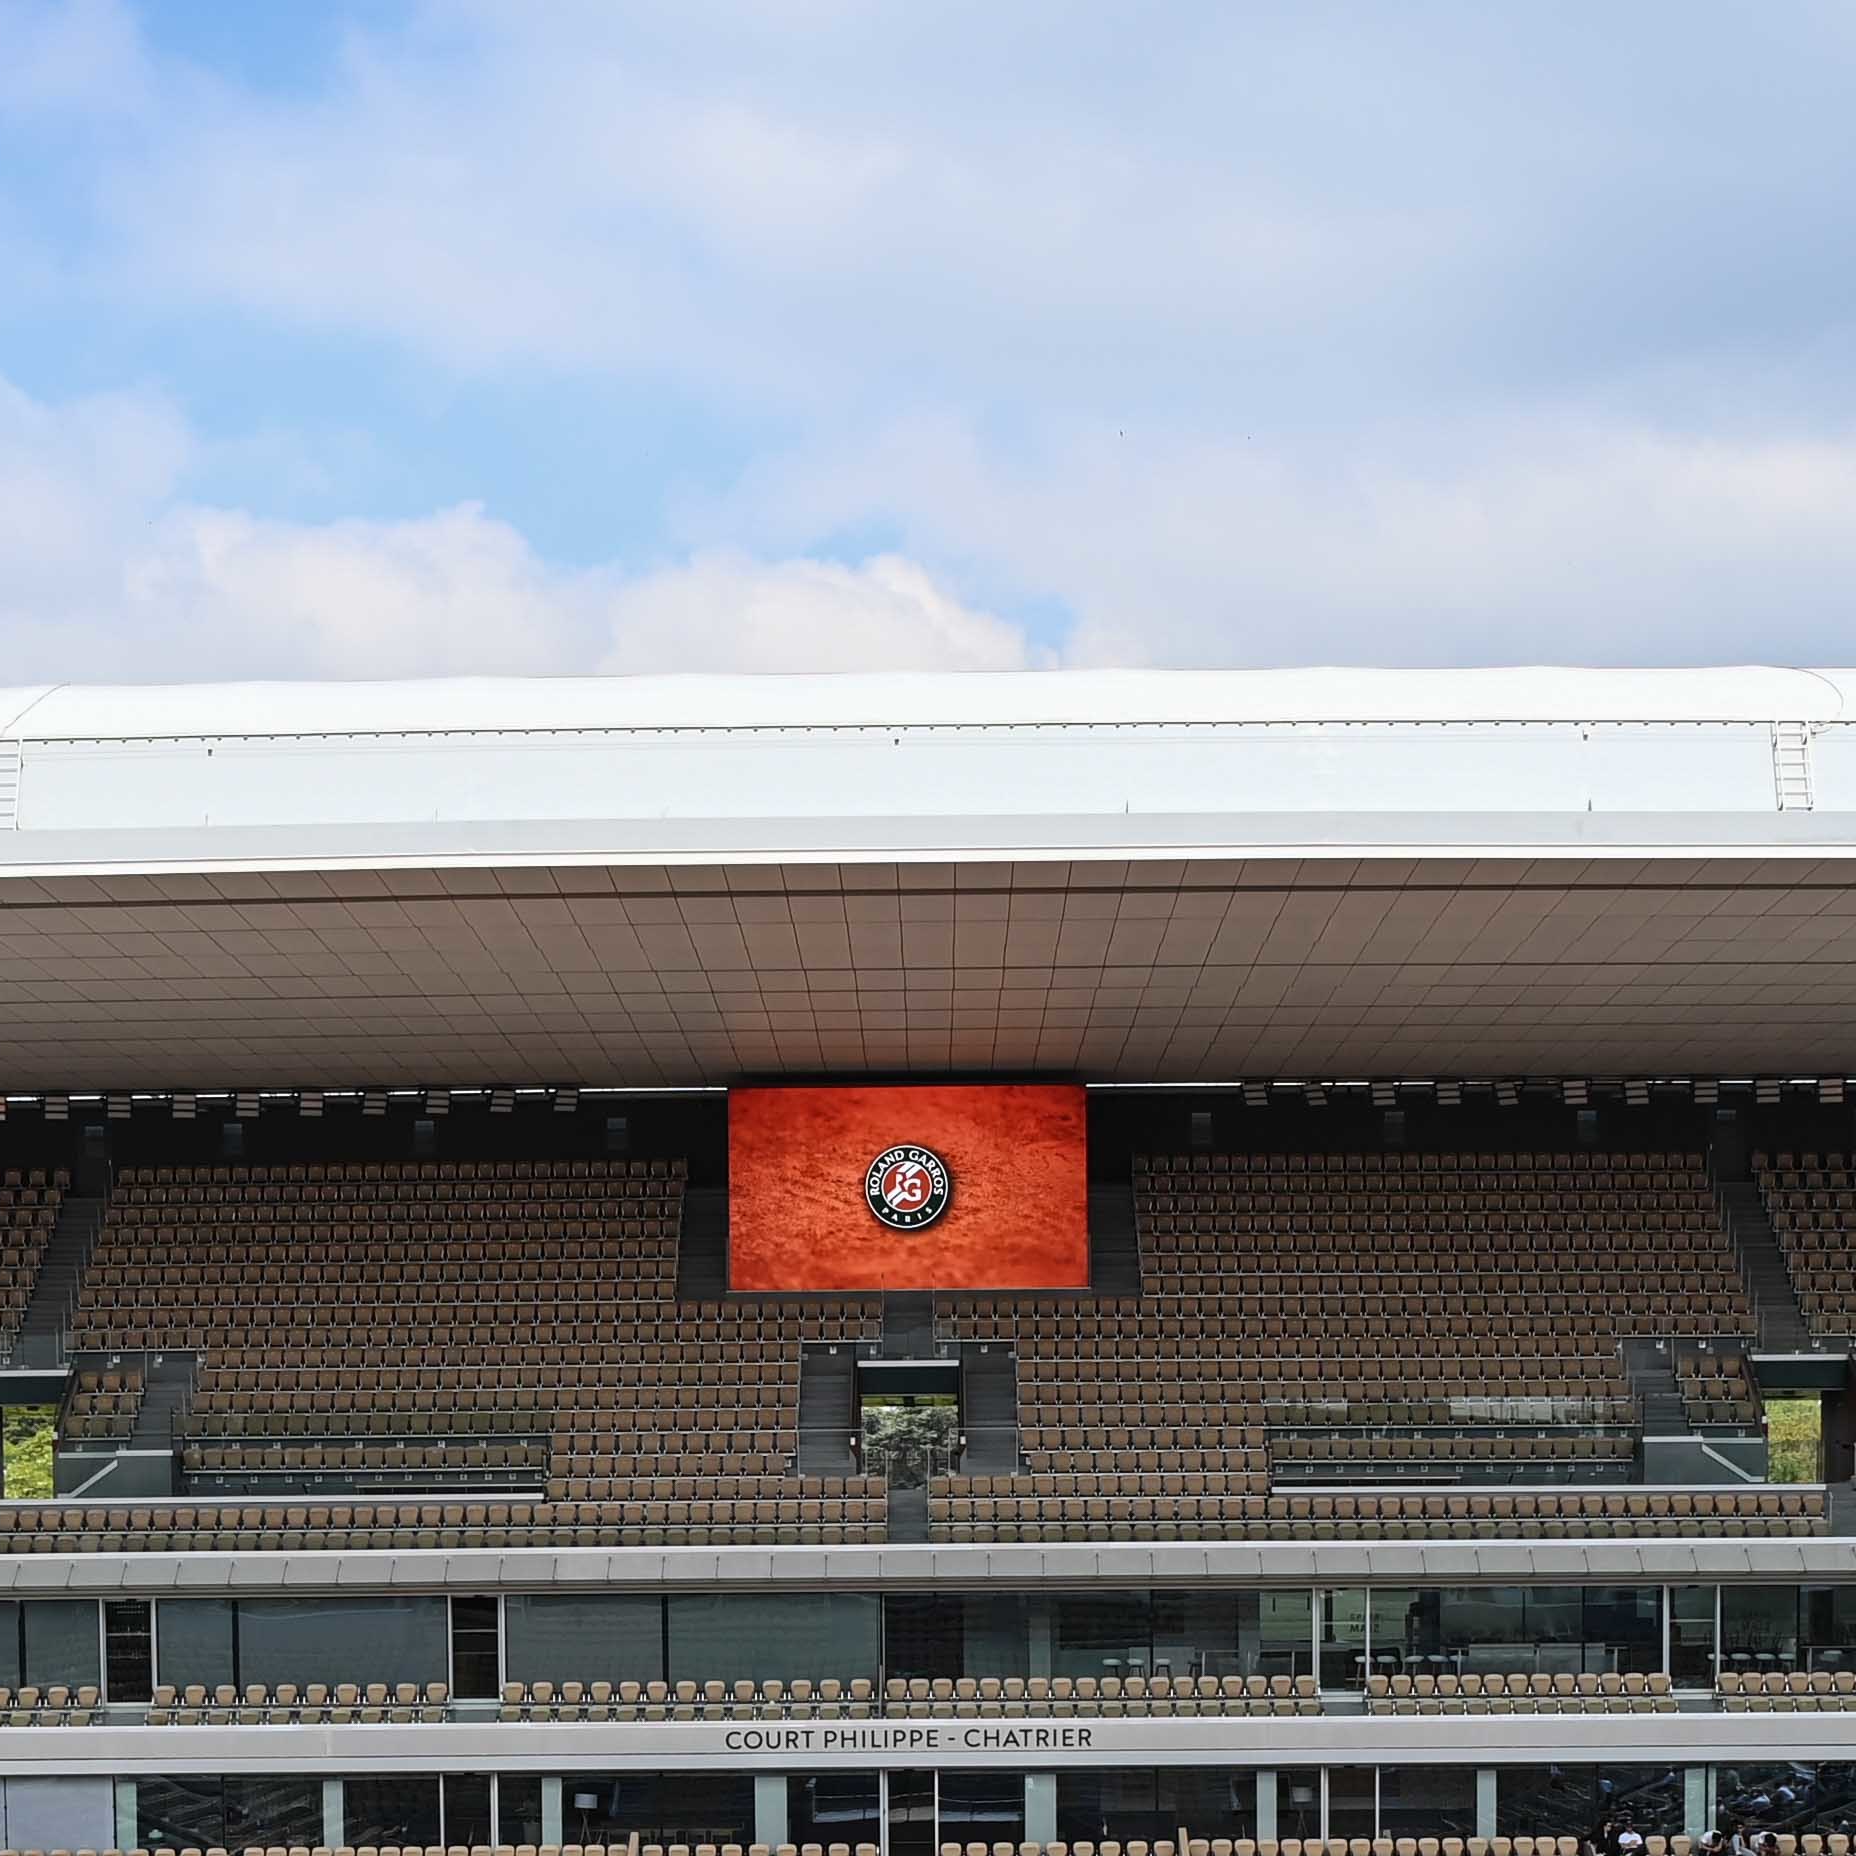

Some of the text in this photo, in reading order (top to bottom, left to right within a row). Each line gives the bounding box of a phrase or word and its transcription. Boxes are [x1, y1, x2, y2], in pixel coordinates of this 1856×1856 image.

[870, 1150, 944, 1196] ROLAND GARROS
[725, 1730, 815, 1750] COURT
[824, 1729, 939, 1748] PHILIPPE
[964, 1728, 1092, 1747] CHATRIER
